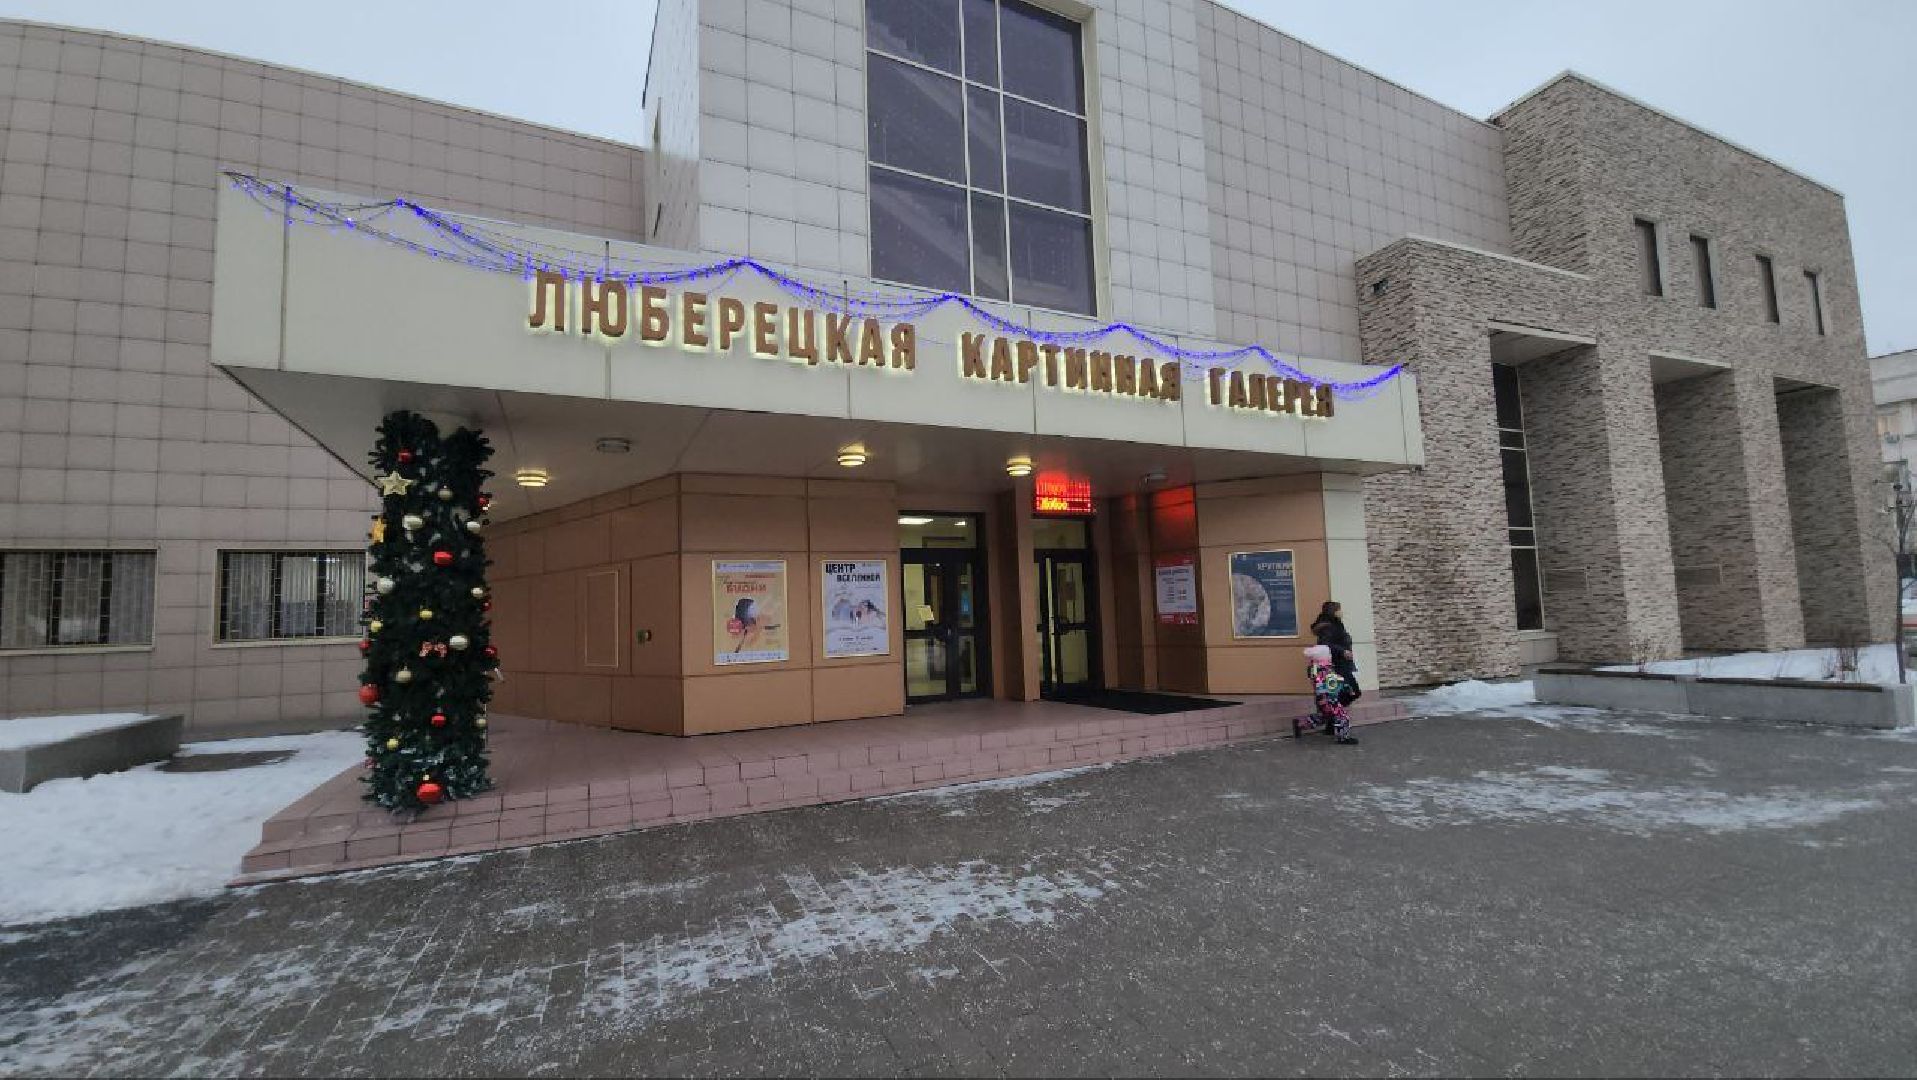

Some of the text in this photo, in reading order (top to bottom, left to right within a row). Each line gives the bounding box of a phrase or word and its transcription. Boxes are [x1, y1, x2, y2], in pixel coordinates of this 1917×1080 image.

[528, 270, 1335, 418] ЛЮБЕРЕЦКАЯ КАРТИННАЯ ГАЛЕРЕЯ
[825, 563, 856, 575] ЦЕНТР
